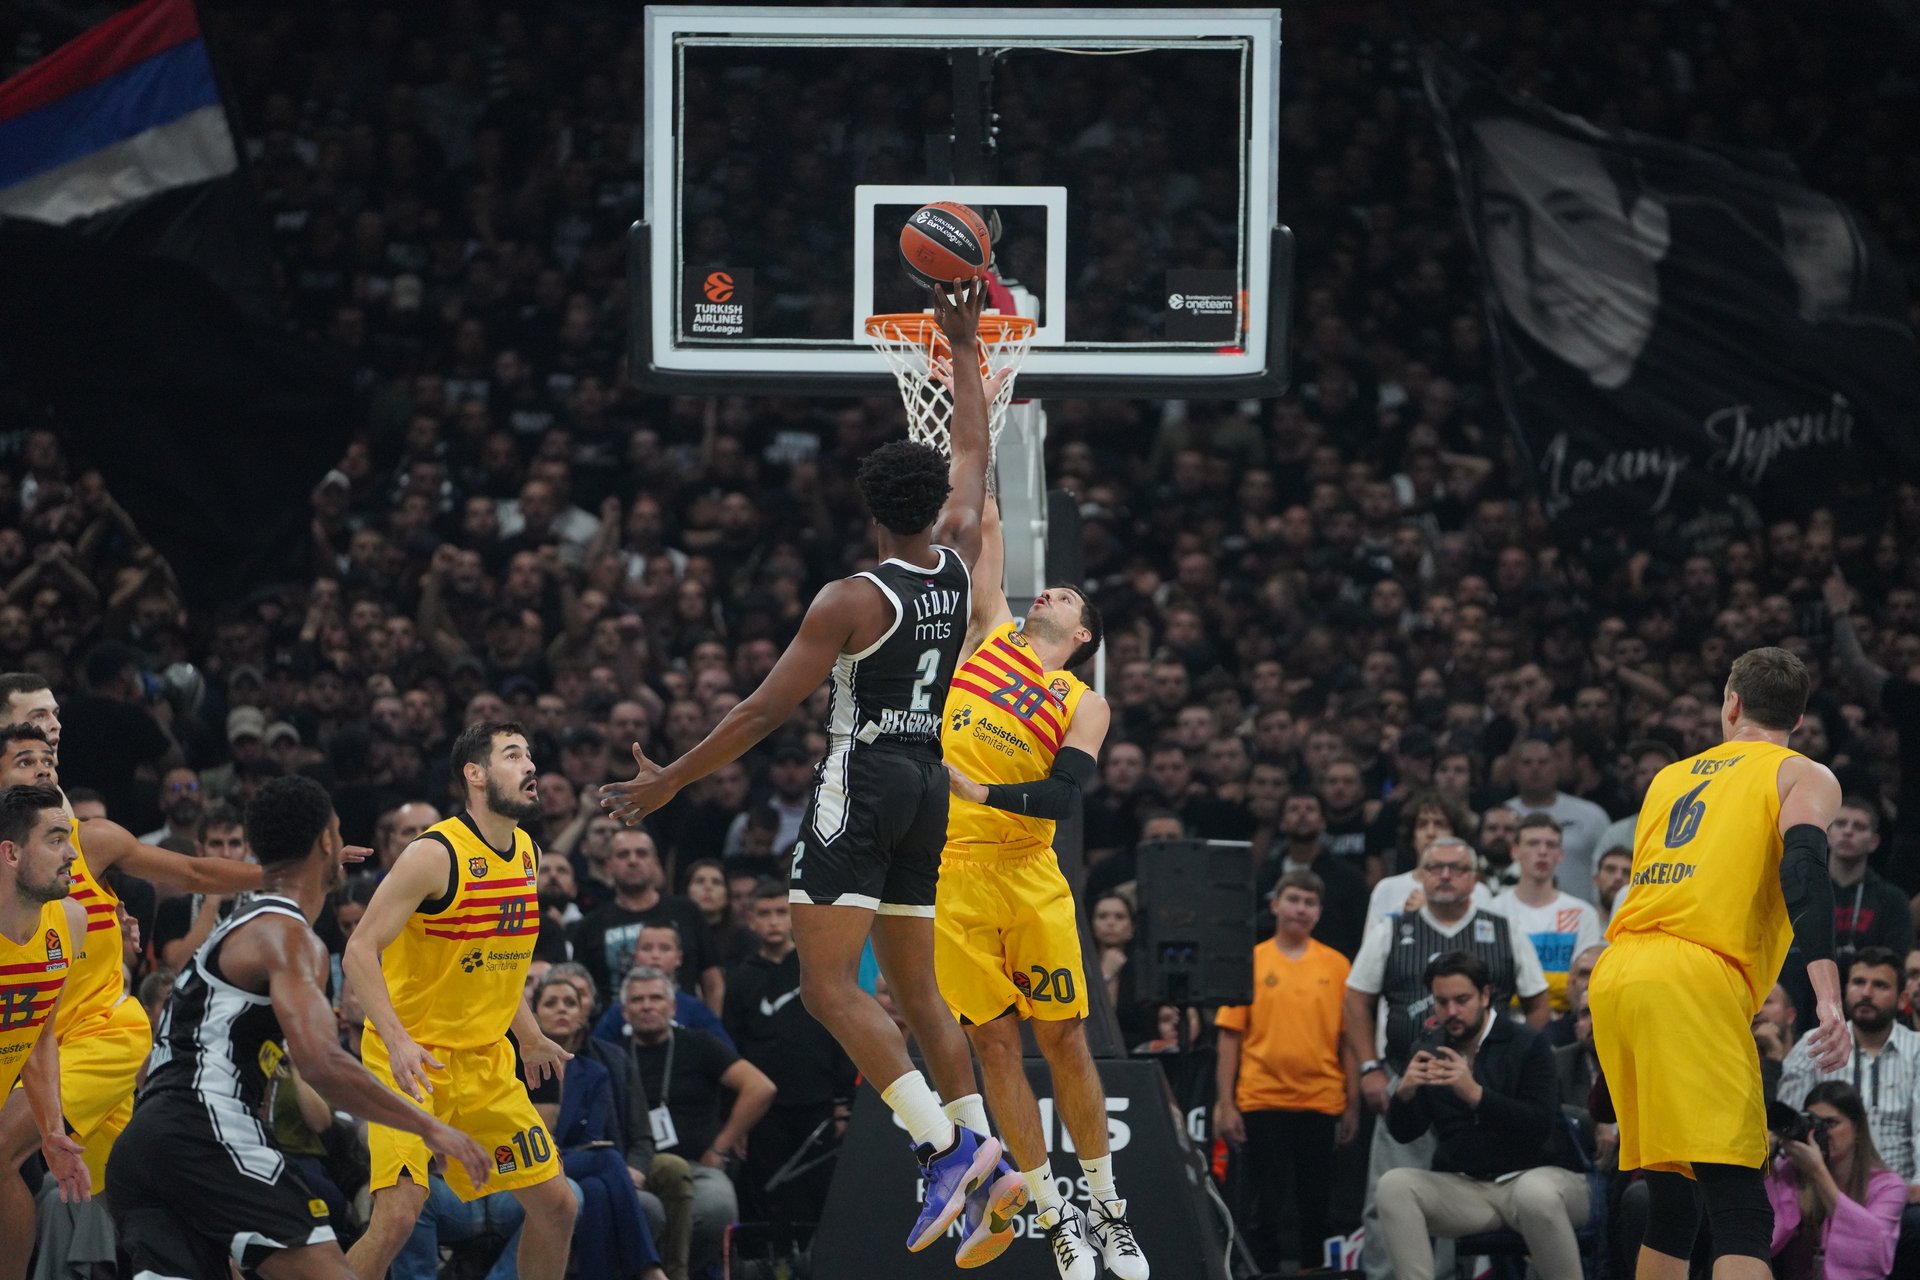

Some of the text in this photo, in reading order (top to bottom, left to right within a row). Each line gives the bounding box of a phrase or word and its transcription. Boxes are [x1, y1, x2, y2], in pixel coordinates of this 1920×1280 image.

[926, 219, 963, 247] EuroLeague
[931, 215, 956, 232] TURKISH
[694, 303, 743, 314] TURKISH
[694, 313, 743, 325] AIRLINES
[1185, 300, 1233, 309] oneteam
[692, 323, 744, 335] EuroLeague
[913, 590, 960, 621] LEDAY
[915, 620, 951, 640] mts
[909, 648, 941, 712] 2
[989, 671, 1046, 720] 20
[1664, 779, 1712, 849] 6
[791, 841, 806, 880] 2
[496, 897, 526, 934] 10
[1031, 965, 1075, 1004] 20
[1, 987, 38, 1029] 13
[512, 1126, 550, 1168] 10
